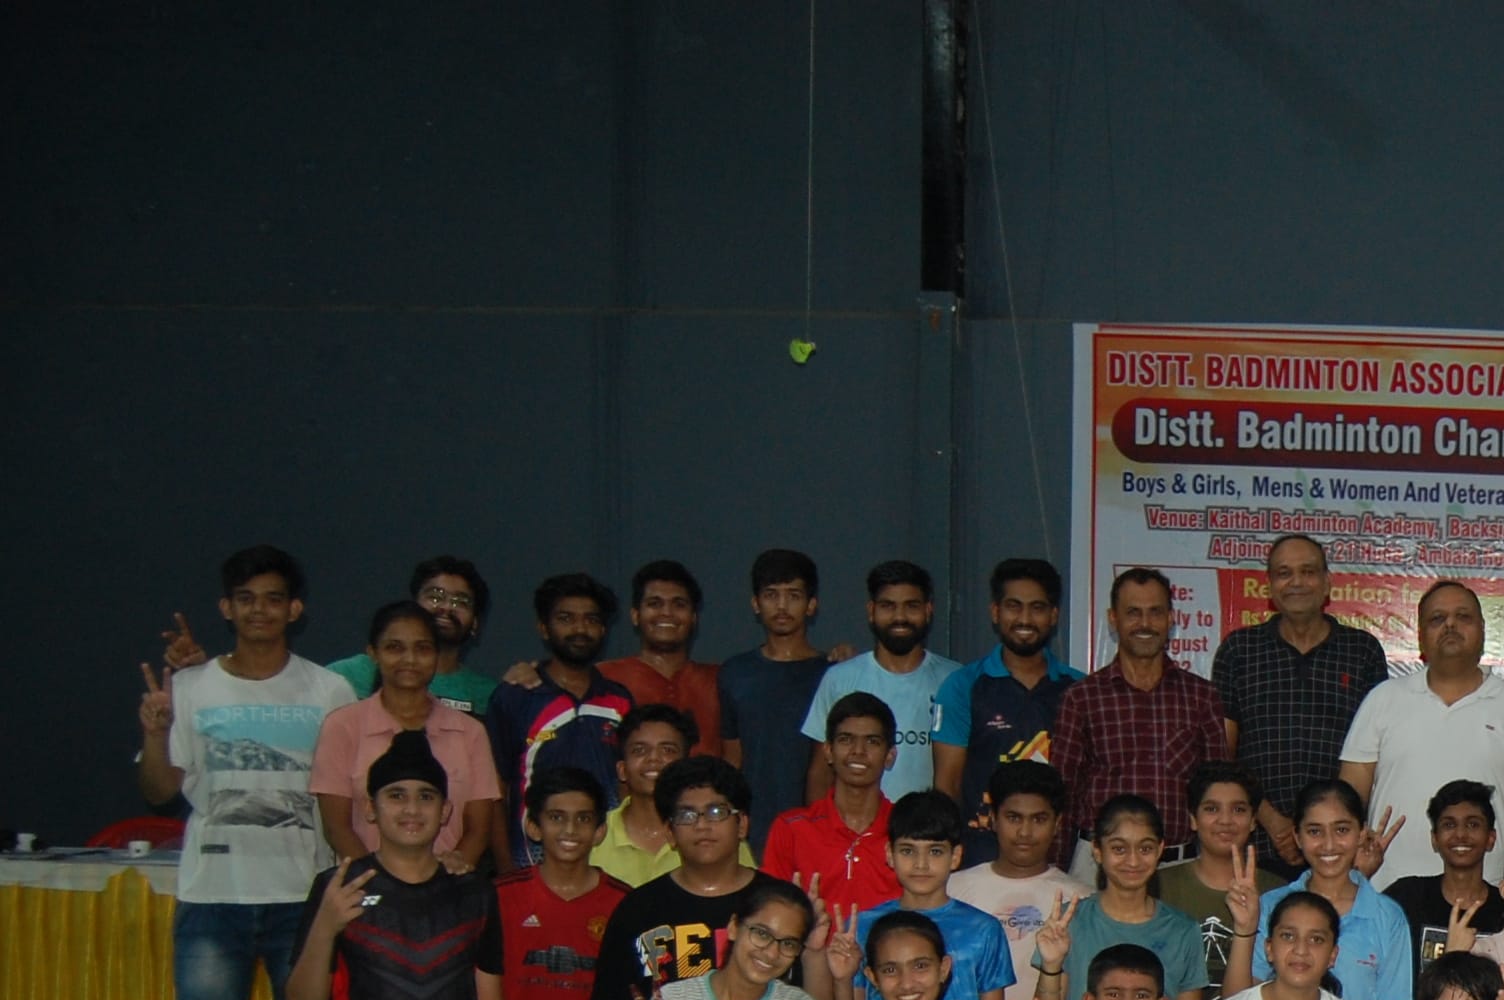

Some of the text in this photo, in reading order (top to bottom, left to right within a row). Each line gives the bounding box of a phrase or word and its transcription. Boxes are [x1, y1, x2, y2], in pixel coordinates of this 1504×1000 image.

[1108, 352, 1196, 387] DISTT.
[1206, 355, 1380, 392] BADMINTON
[1134, 407, 1225, 448] Distt.
[1237, 411, 1422, 455] Badminton
[1122, 472, 1166, 497] Boys
[1171, 473, 1187, 494] &
[1192, 474, 1242, 499] Girls,
[1252, 476, 1304, 499] Mens
[1310, 478, 1326, 499] &
[1329, 478, 1400, 502] Women
[1404, 482, 1441, 504] And
[1148, 508, 1202, 529] Venue:
[1208, 508, 1266, 531] Kaithal
[1271, 511, 1357, 533] Badminton
[1362, 514, 1439, 540] Academy,
